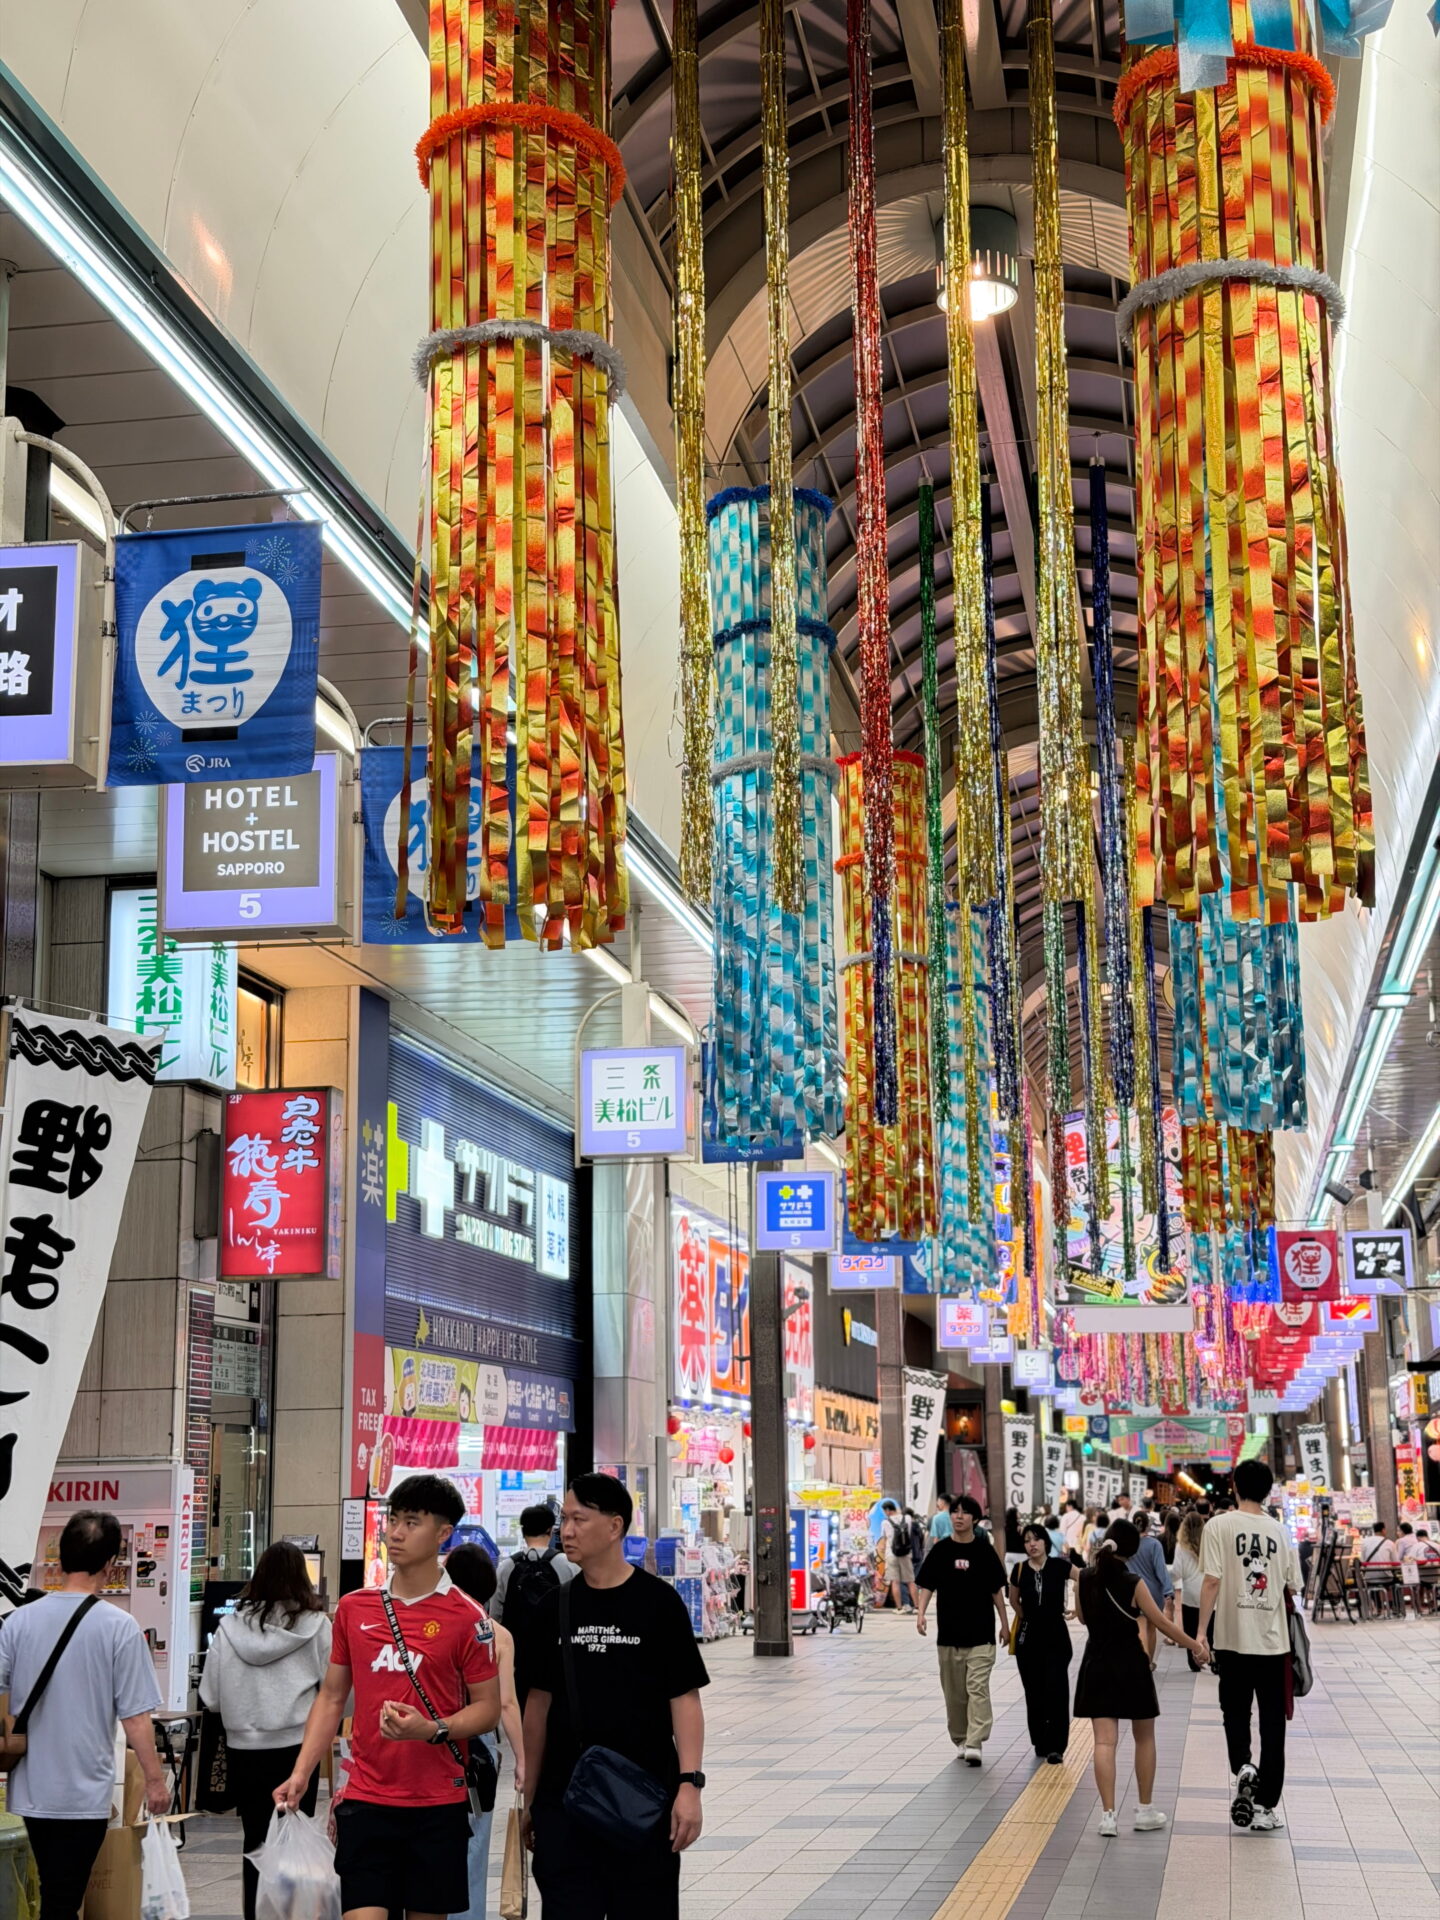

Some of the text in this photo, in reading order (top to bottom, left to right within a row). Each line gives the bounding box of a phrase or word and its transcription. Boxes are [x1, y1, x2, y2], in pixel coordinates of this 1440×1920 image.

[0, 650, 32, 696] 路
[181, 687, 245, 719] まつり
[207, 755, 231, 770] JRA
[205, 786, 299, 810] HOTEL
[202, 829, 300, 853] HOSTEL
[217, 861, 285, 876] SAPPORO
[239, 893, 262, 919] 5
[606, 1064, 661, 1090] 三条
[229, 1095, 242, 1104] 2F
[594, 1095, 674, 1124] 美松ビル
[280, 1094, 321, 1174] 白老牛
[626, 1131, 641, 1148] 5
[228, 1133, 289, 1228] 徳寿
[456, 1139, 534, 1227] サツドラ
[779, 1202, 812, 1210] サツドラ
[273, 1226, 317, 1236] YAKINIKU
[791, 1233, 801, 1245] 5
[1355, 1242, 1401, 1257] サツ
[858, 1273, 868, 1284] 5
[1300, 1276, 1320, 1285] まつり
[432, 1315, 539, 1364] HOKKAIDO HAPPY LIFE STYLE
[361, 1387, 377, 1407] TAX
[358, 1411, 384, 1432] FREE
[47, 1480, 120, 1502] KIRIN
[180, 1494, 191, 1570] KIRIN
[1235, 1532, 1278, 1561] GAP
[587, 1643, 607, 1653] 1972
[600, 1635, 641, 1646] GIRBAUD
